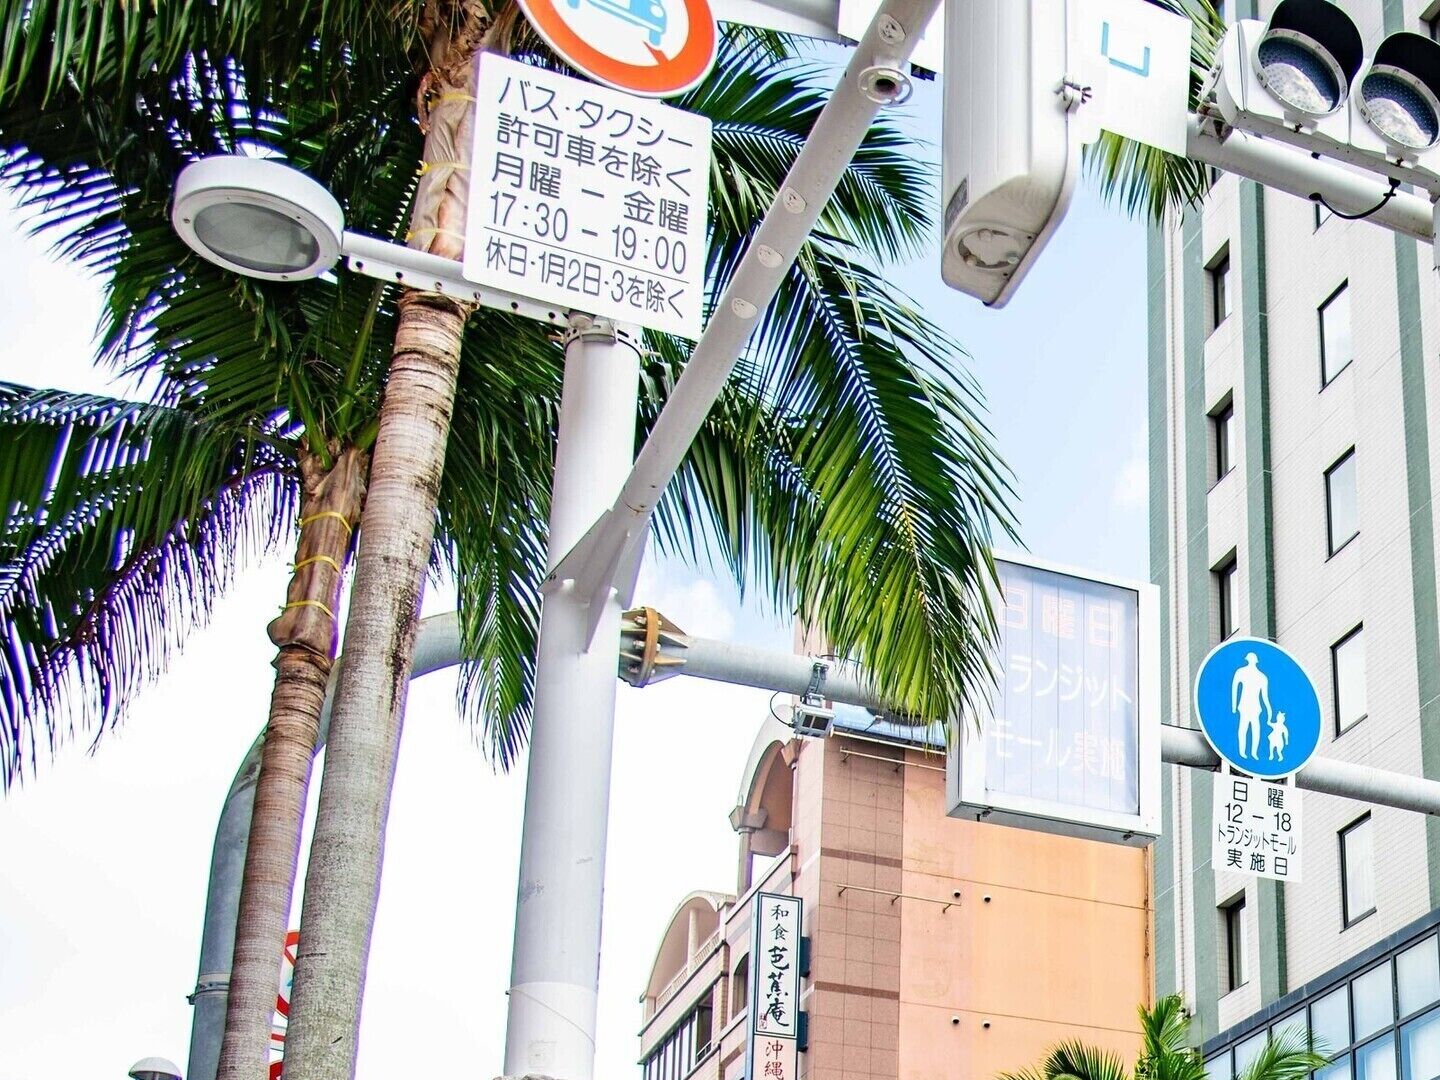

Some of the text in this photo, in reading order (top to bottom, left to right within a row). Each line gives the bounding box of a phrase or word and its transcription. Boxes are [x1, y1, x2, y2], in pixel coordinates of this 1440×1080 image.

[498, 77, 693, 147] バス・タクシー
[497, 112, 692, 197] 許可車を除く
[491, 151, 562, 200] 月曜
[623, 190, 690, 235] 金曜
[490, 190, 569, 242] 17:30
[611, 224, 687, 275] 19:00
[1009, 654, 1133, 708] ランジット
[1224, 802, 1244, 824] 12
[1273, 811, 1292, 832] 18
[1233, 780, 1284, 809] 日曜
[1218, 823, 1297, 855] トランジットモール
[1226, 848, 1288, 876] 実施日
[770, 904, 789, 941] 和食
